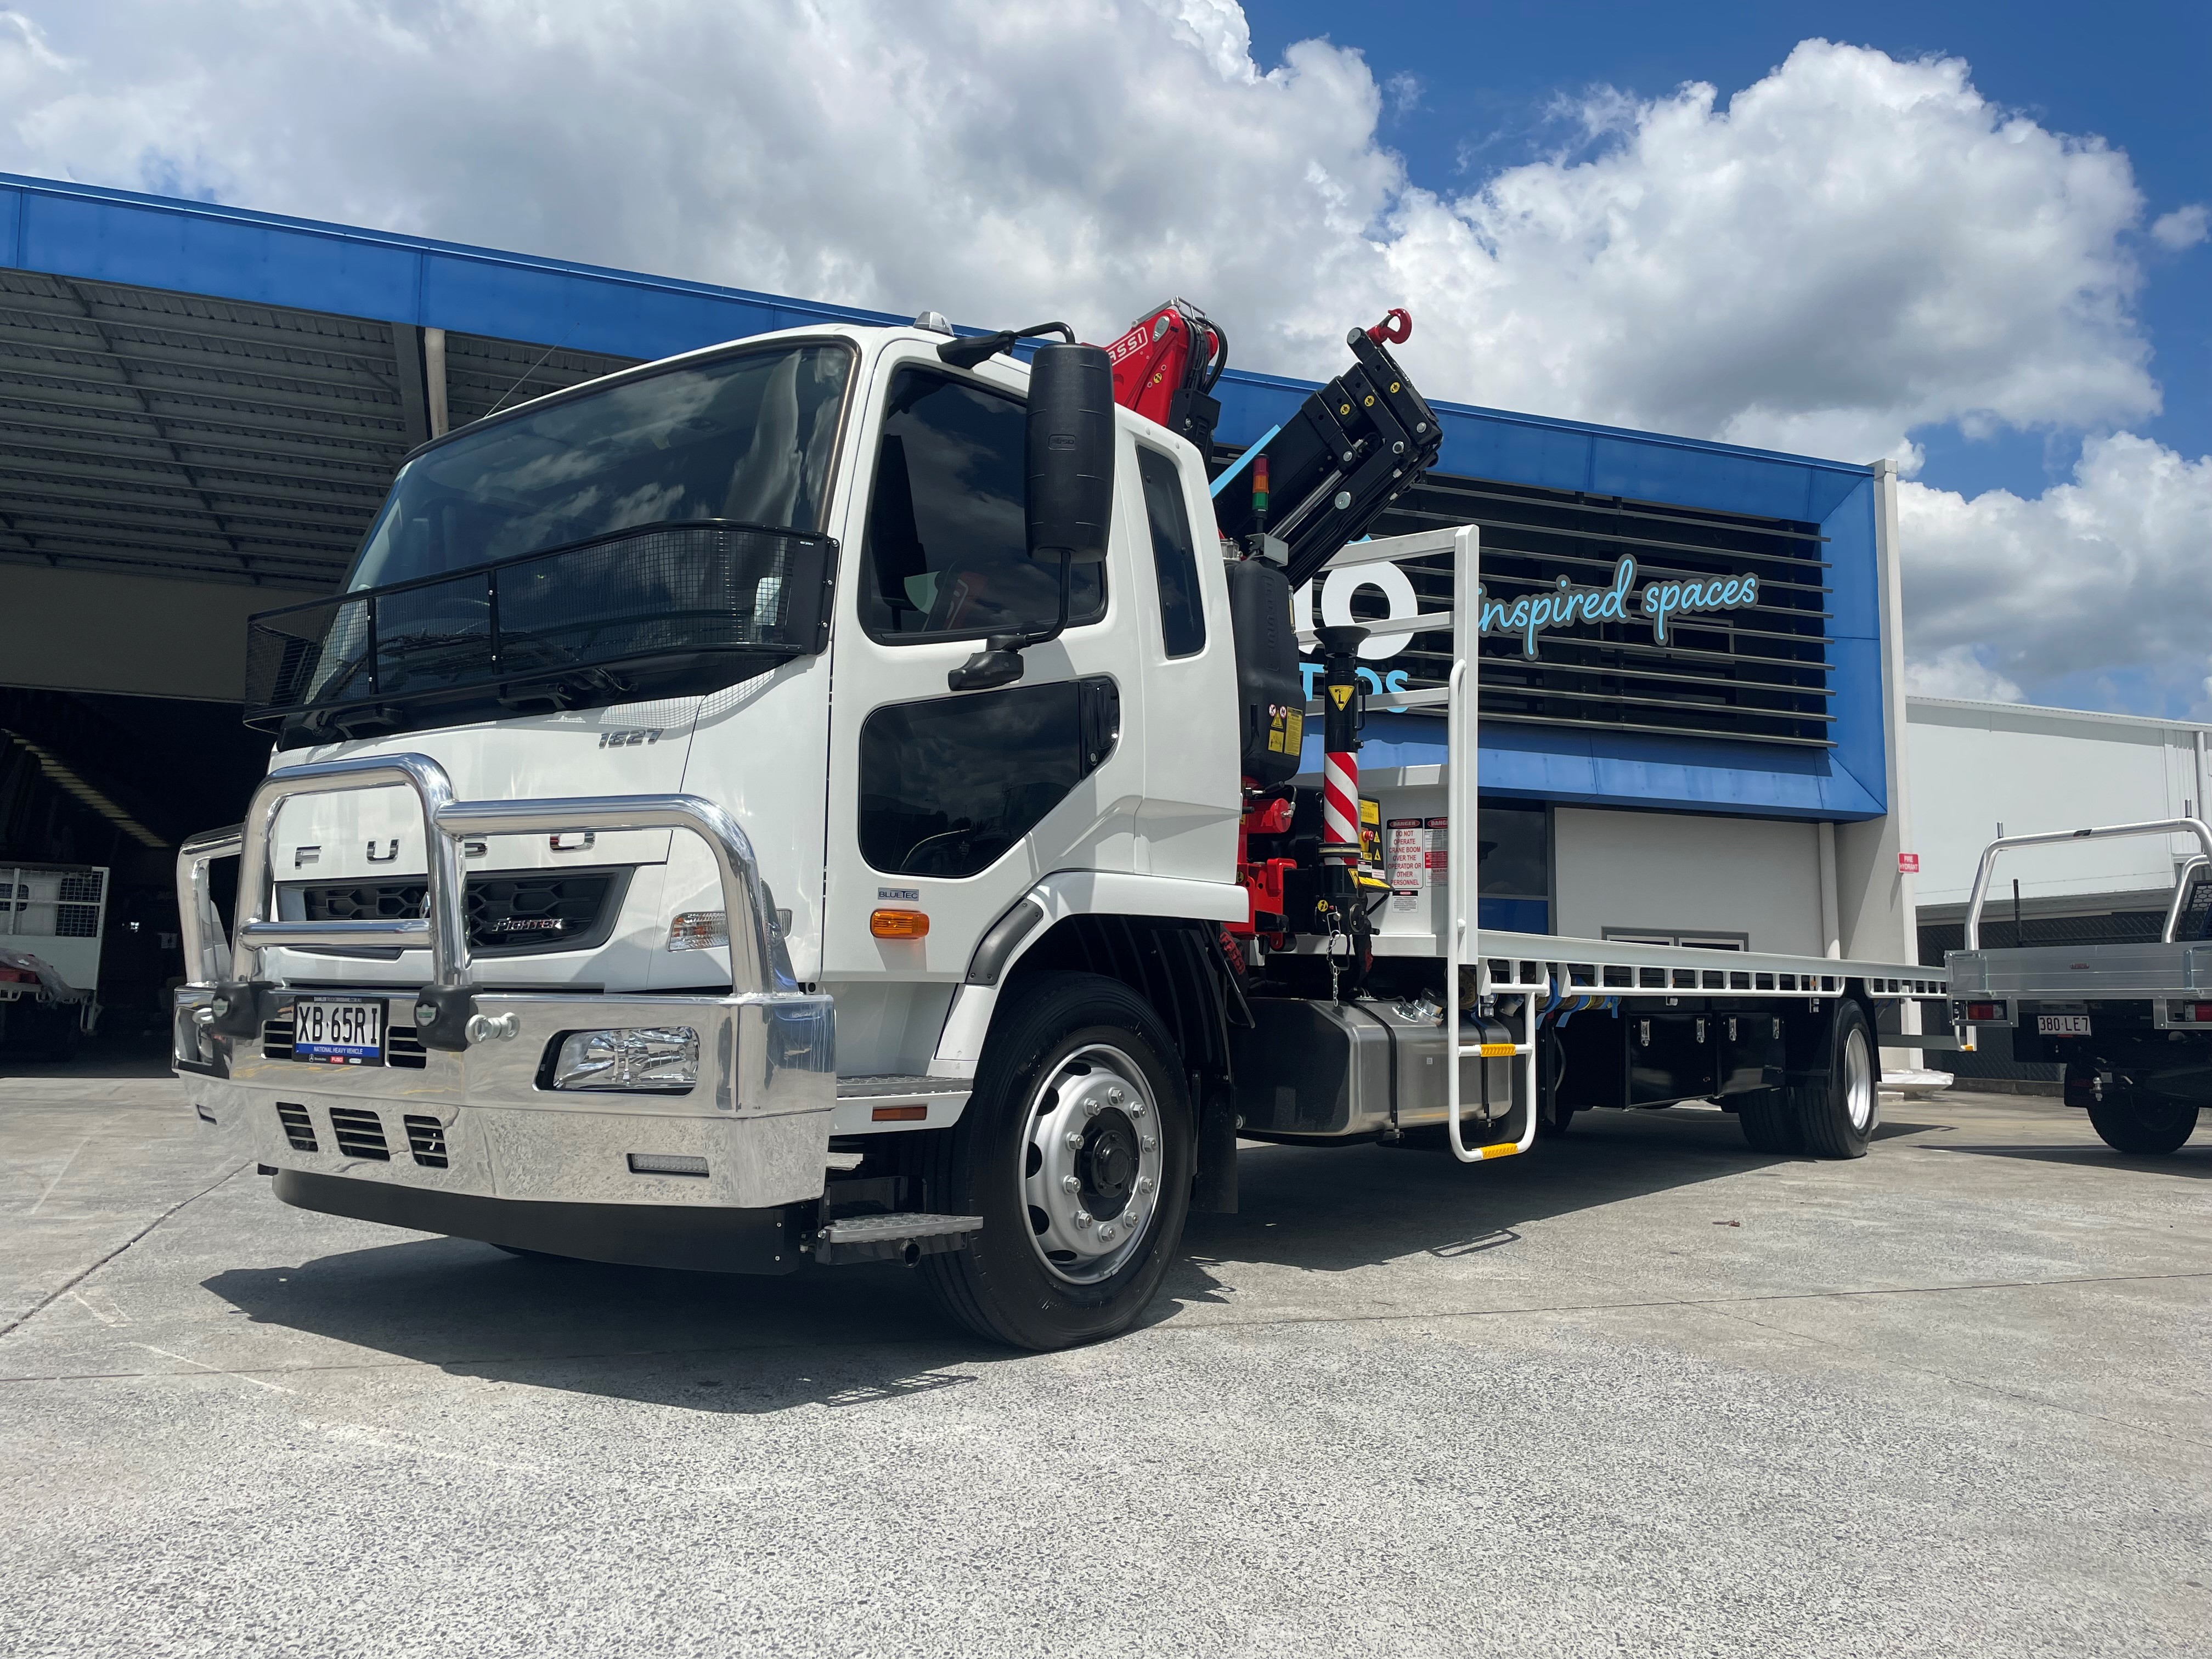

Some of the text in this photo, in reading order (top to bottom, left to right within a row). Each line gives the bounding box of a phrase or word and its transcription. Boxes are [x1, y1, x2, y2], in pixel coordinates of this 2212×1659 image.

[1108, 333, 1143, 360] ASSI
[1646, 577, 1756, 640] spaces
[599, 728, 664, 749] 1627
